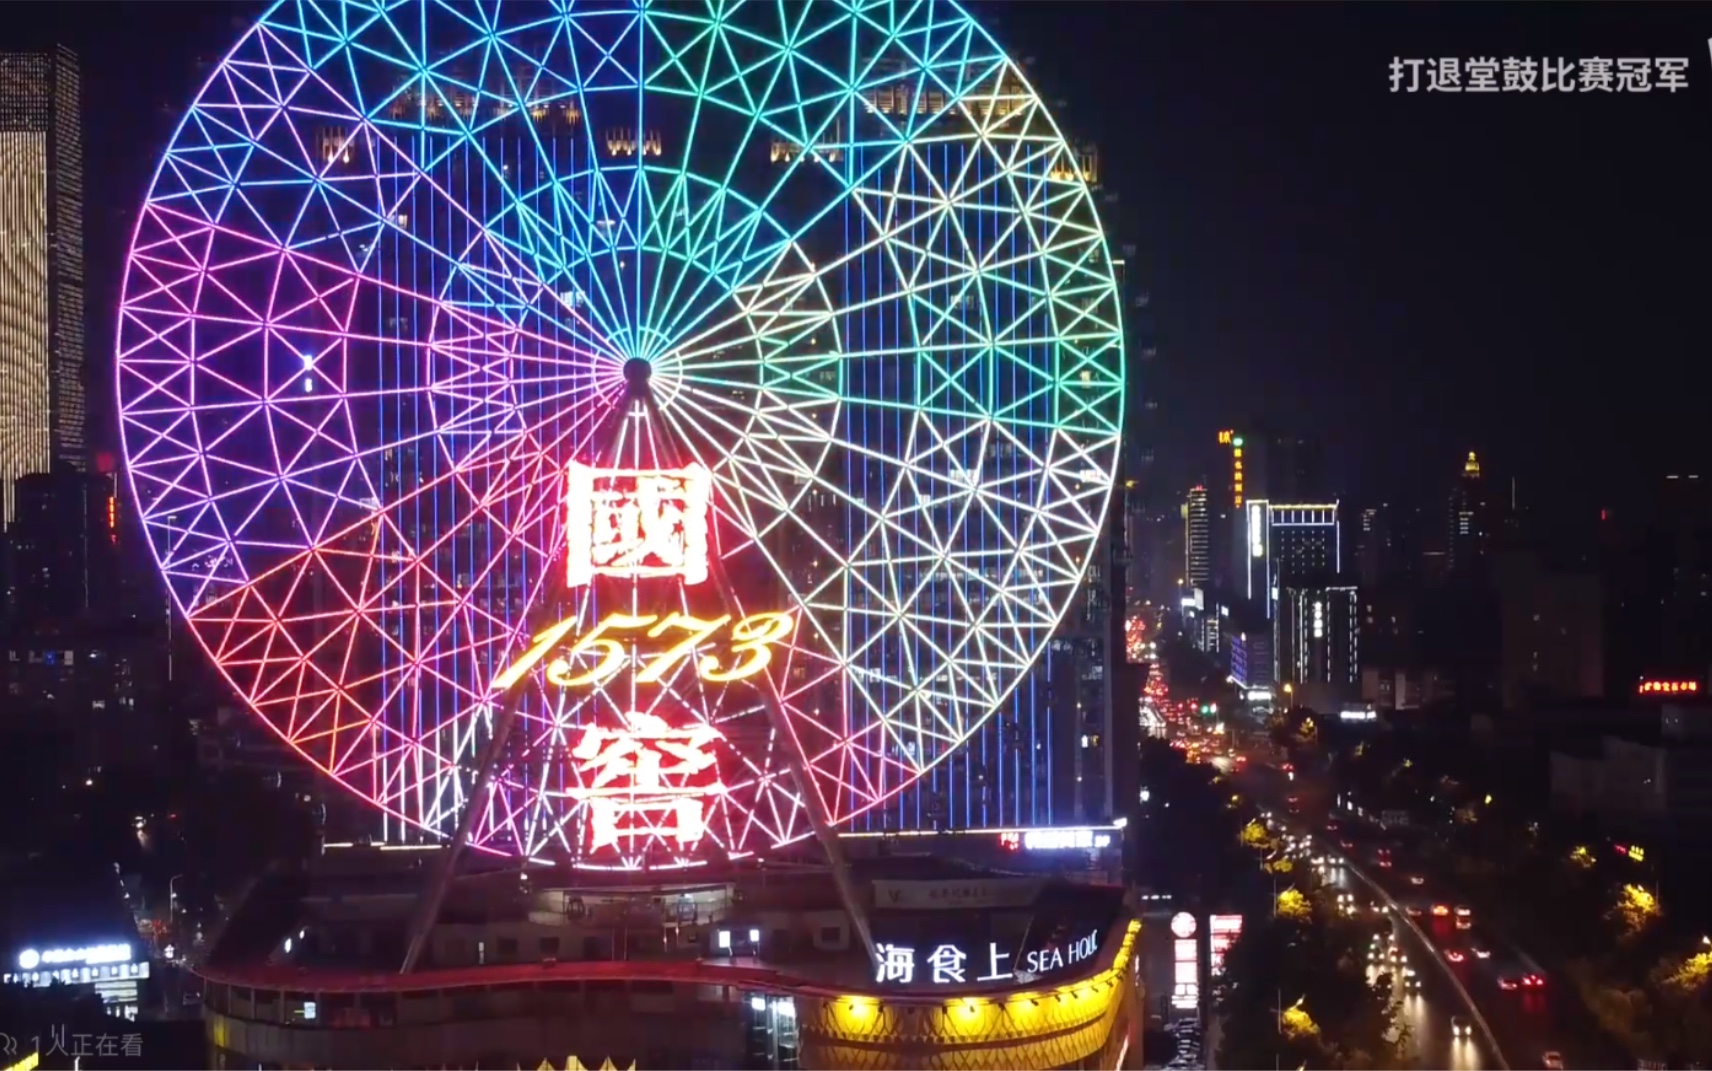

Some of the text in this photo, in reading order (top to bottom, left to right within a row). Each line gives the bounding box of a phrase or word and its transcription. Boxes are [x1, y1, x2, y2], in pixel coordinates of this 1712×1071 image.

[490, 612, 795, 688] 1573
[875, 943, 1013, 984] 海食上
[1027, 946, 1064, 974] SEA
